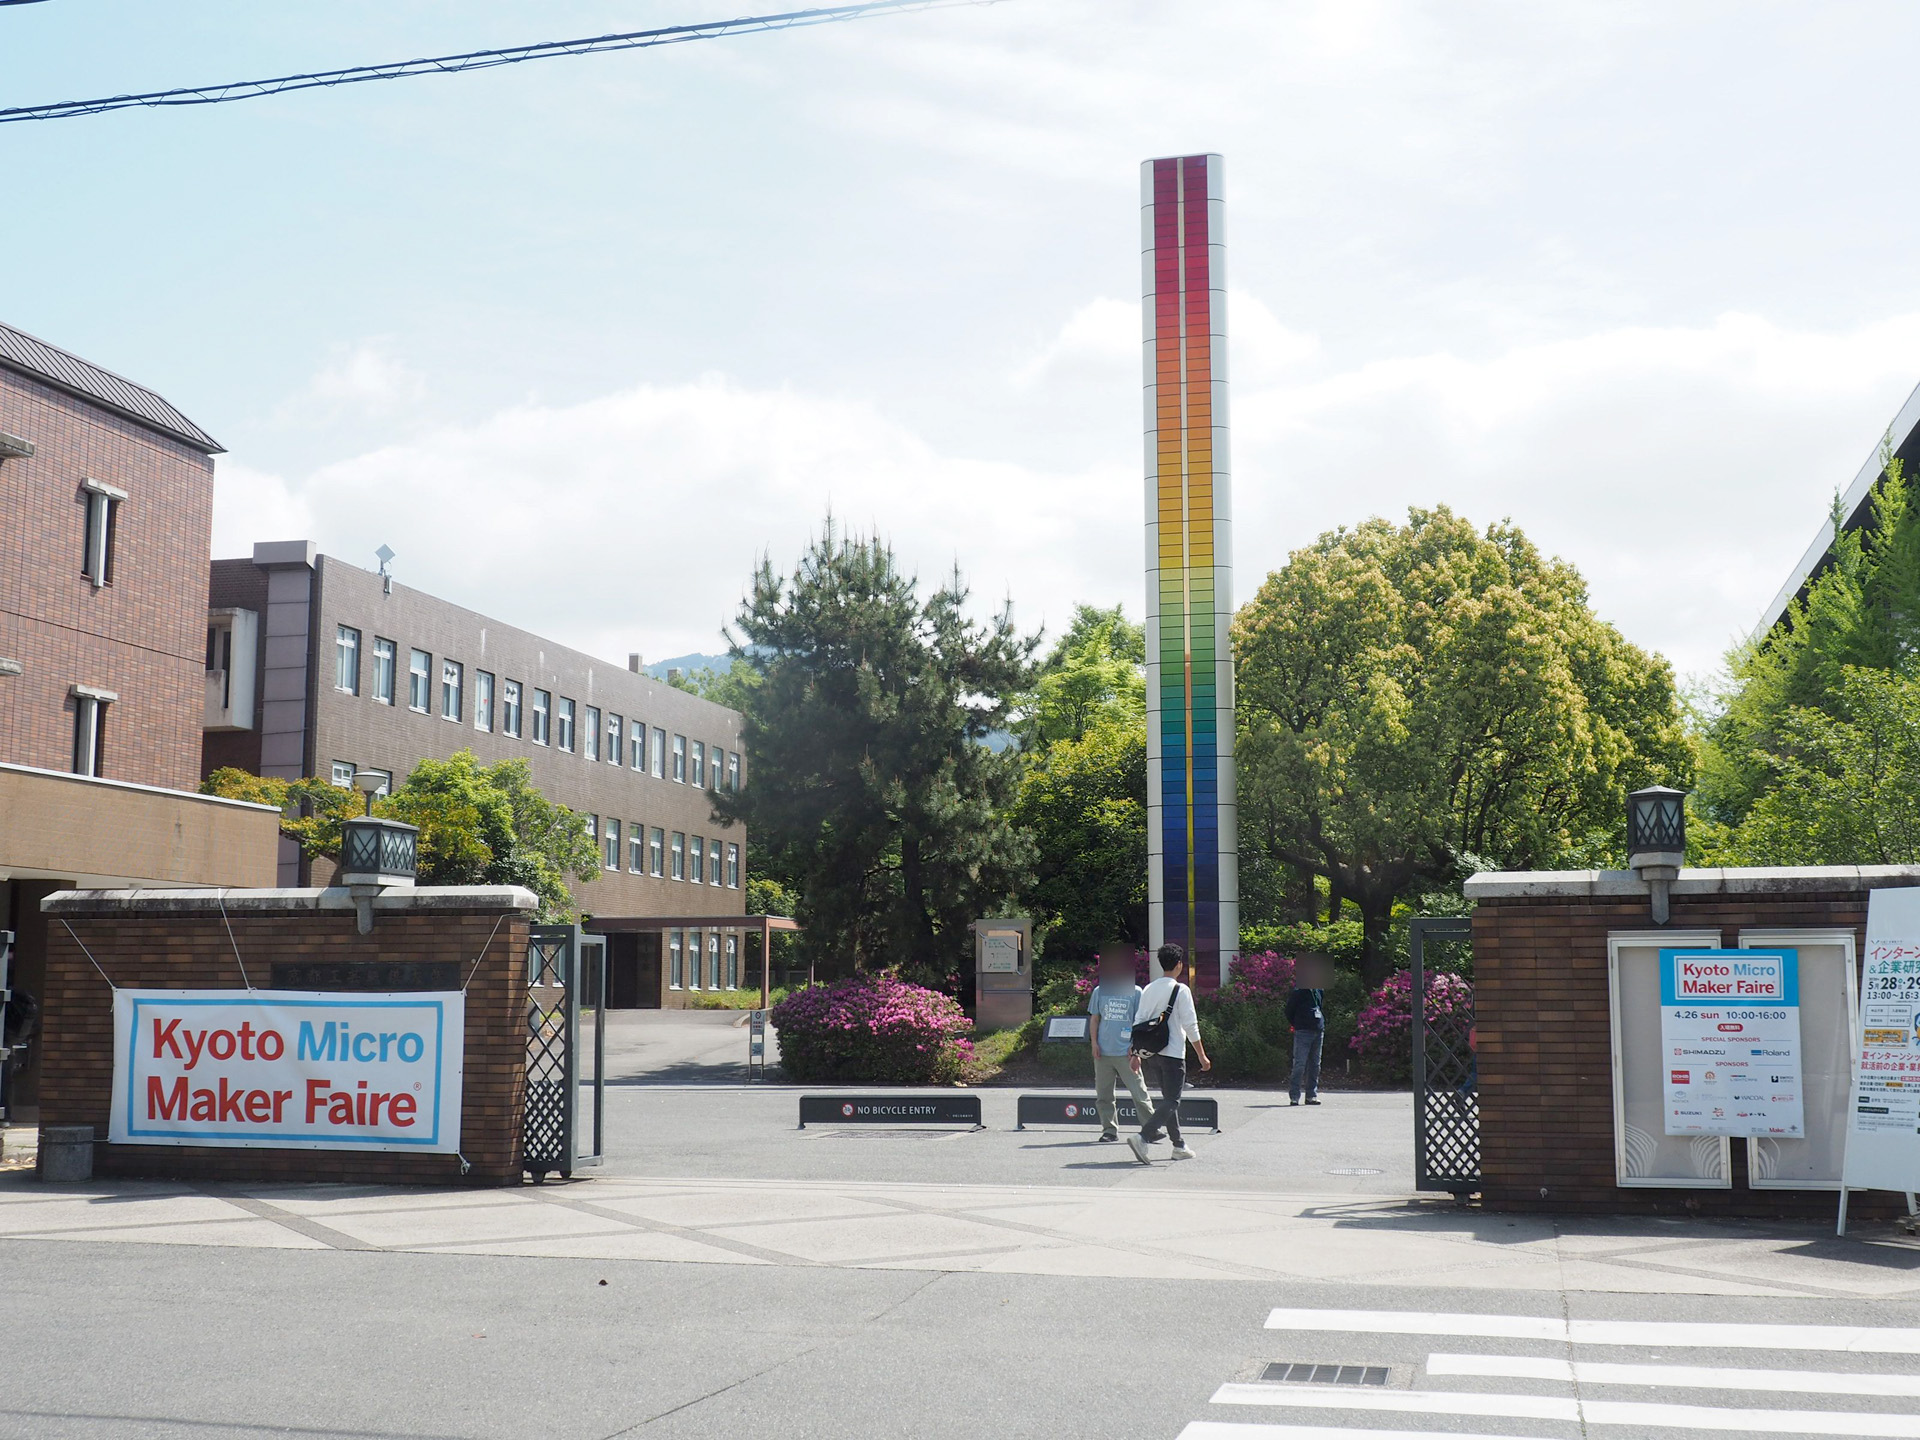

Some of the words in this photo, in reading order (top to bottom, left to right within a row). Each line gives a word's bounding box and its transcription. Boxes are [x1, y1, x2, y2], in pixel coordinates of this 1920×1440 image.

[1683, 963, 1730, 979] Kyoto
[1733, 963, 1776, 976] Micro
[1683, 980, 1733, 994] Maker
[1736, 980, 1775, 994] Faire
[1109, 1001, 1127, 1009] Micro
[1674, 1010, 1698, 1019] 4.26
[1726, 1011, 1787, 1020] 10:00-16:00
[152, 1018, 285, 1071] Kyoto
[297, 1020, 425, 1063] Micro
[1762, 1049, 1791, 1057] Roland
[147, 1075, 293, 1124] Maker
[857, 1106, 871, 1115] NO
[872, 1106, 907, 1115] BICYCLE
[909, 1106, 937, 1115] ENTRY
[1082, 1107, 1096, 1116] NO
